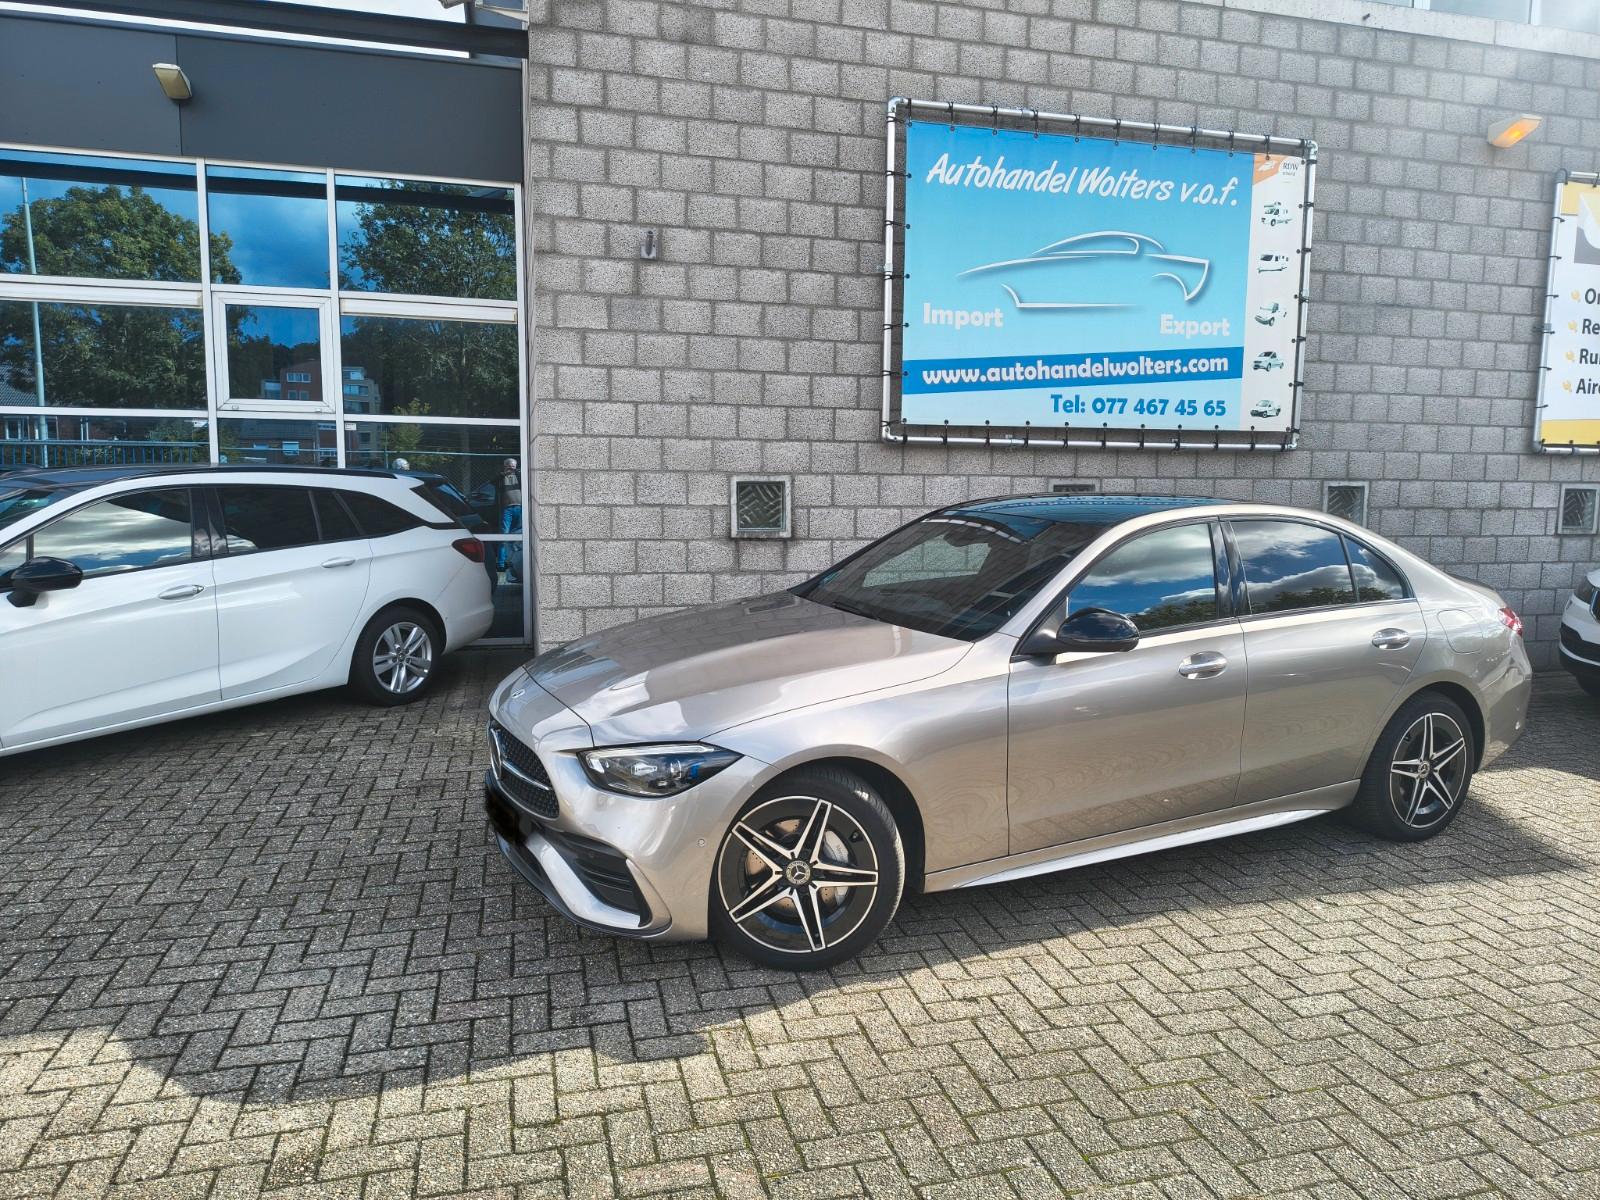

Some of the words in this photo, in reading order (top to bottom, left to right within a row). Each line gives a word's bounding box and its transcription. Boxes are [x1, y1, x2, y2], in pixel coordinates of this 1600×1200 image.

[926, 153, 1078, 194] Autohandel
[1077, 166, 1174, 201] Wolters
[1180, 176, 1239, 206] v.o.f.
[923, 302, 1003, 330] Import
[1160, 314, 1230, 338] Export
[1579, 348, 1600, 364] Ru
[922, 356, 1229, 385] www.autohandelwolters.com
[1050, 394, 1086, 413] Tel:
[1091, 397, 1128, 414] 077
[1133, 398, 1170, 415] 467
[1174, 399, 1198, 416] 45
[1203, 400, 1226, 416] 65
